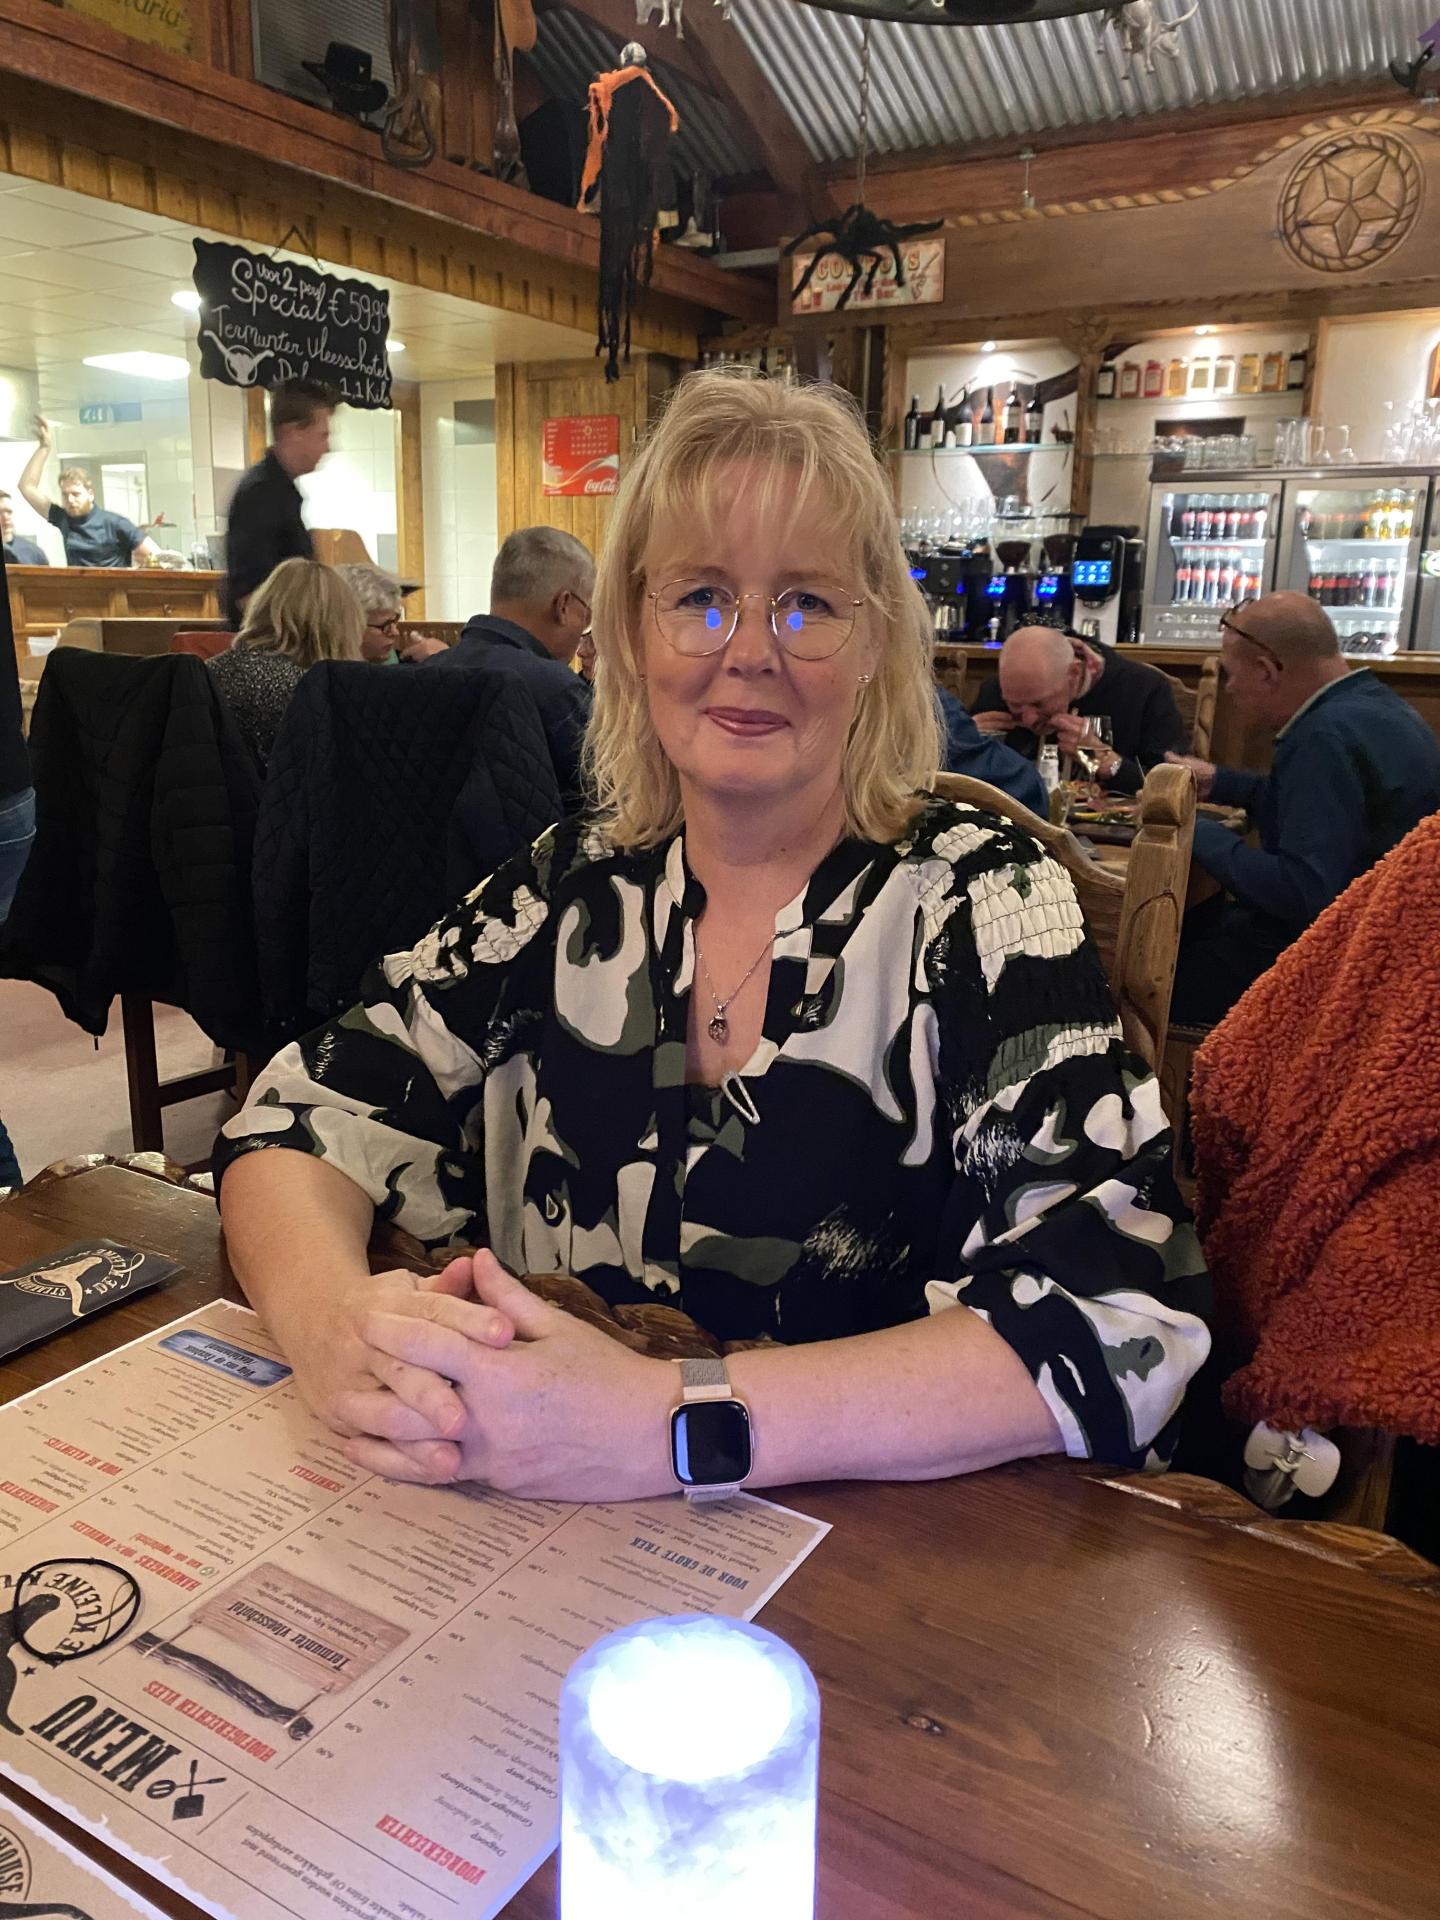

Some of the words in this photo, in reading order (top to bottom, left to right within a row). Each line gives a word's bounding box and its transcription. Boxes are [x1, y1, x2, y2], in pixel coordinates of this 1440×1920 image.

[231, 257, 327, 322] Special
[282, 267, 298, 291] 2
[211, 304, 303, 356] Termunter
[366, 378, 390, 406] Kilo
[93, 1276, 118, 1295] DE
[286, 1464, 346, 1493] SCHNITZELS
[628, 1535, 663, 1555] TREK
[660, 1548, 701, 1570] GROTE
[133, 1553, 203, 1591] HAMBURGERS
[697, 1563, 718, 1577] DE
[716, 1571, 749, 1590] VOOR
[43, 1572, 103, 1635] KLEINE
[223, 1600, 294, 1640] vleesschotel
[285, 1631, 354, 1672] Termunter
[140, 1679, 182, 1705] VLEES
[28, 1690, 183, 1793] MENU
[173, 1697, 279, 1762] HOOFDGERECHTEN
[523, 1775, 561, 1799] Cowboy
[373, 1813, 487, 1885] VOORGERECHTEN
[329, 1875, 349, 1891] OF
